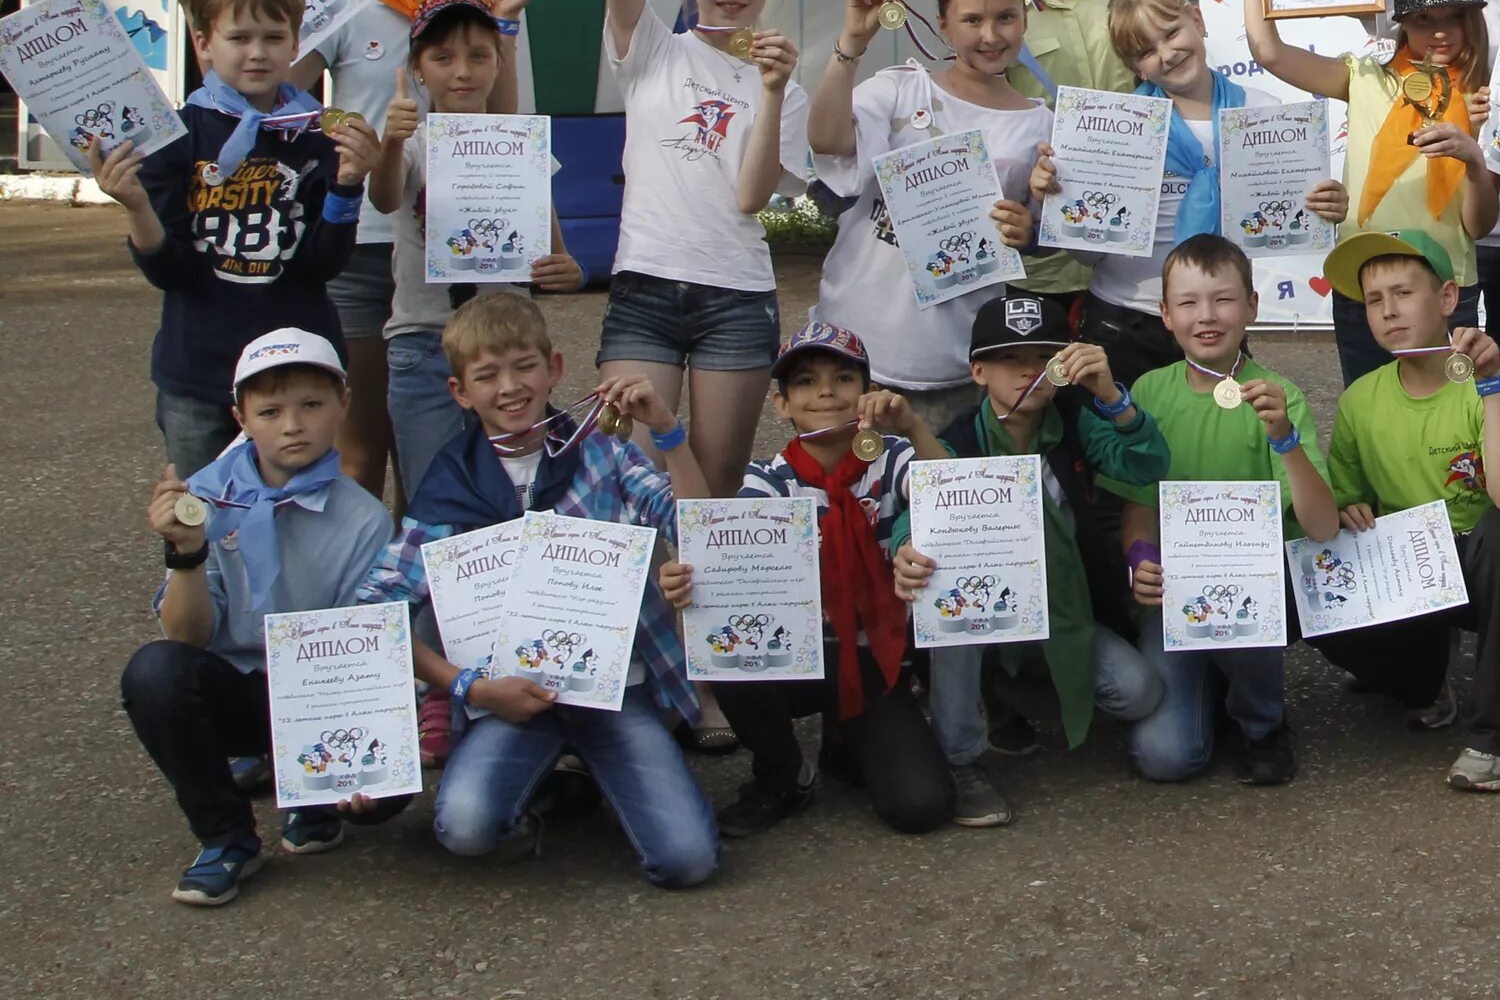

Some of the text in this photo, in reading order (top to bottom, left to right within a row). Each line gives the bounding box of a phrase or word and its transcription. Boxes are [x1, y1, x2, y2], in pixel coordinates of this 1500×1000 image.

[16, 18, 89, 64] ДИПЛОМ
[1076, 115, 1144, 136] ДИПЛОМ
[1243, 128, 1307, 148] ДИПЛОМ
[452, 141, 524, 158] ДИПЛОМ
[905, 158, 969, 192] ДИПЛОМ
[1161, 184, 1190, 193] OLC
[1277, 281, 1294, 300] Я
[935, 488, 1013, 510] ДИПЛОМ
[1185, 508, 1255, 525] ДИПЛОМ
[706, 528, 787, 549] ДИПЛОМ
[541, 543, 621, 568] ДИПЛОМ
[1408, 530, 1437, 590] ДИПЛОМ
[296, 636, 380, 663] ДИПЛОМ
